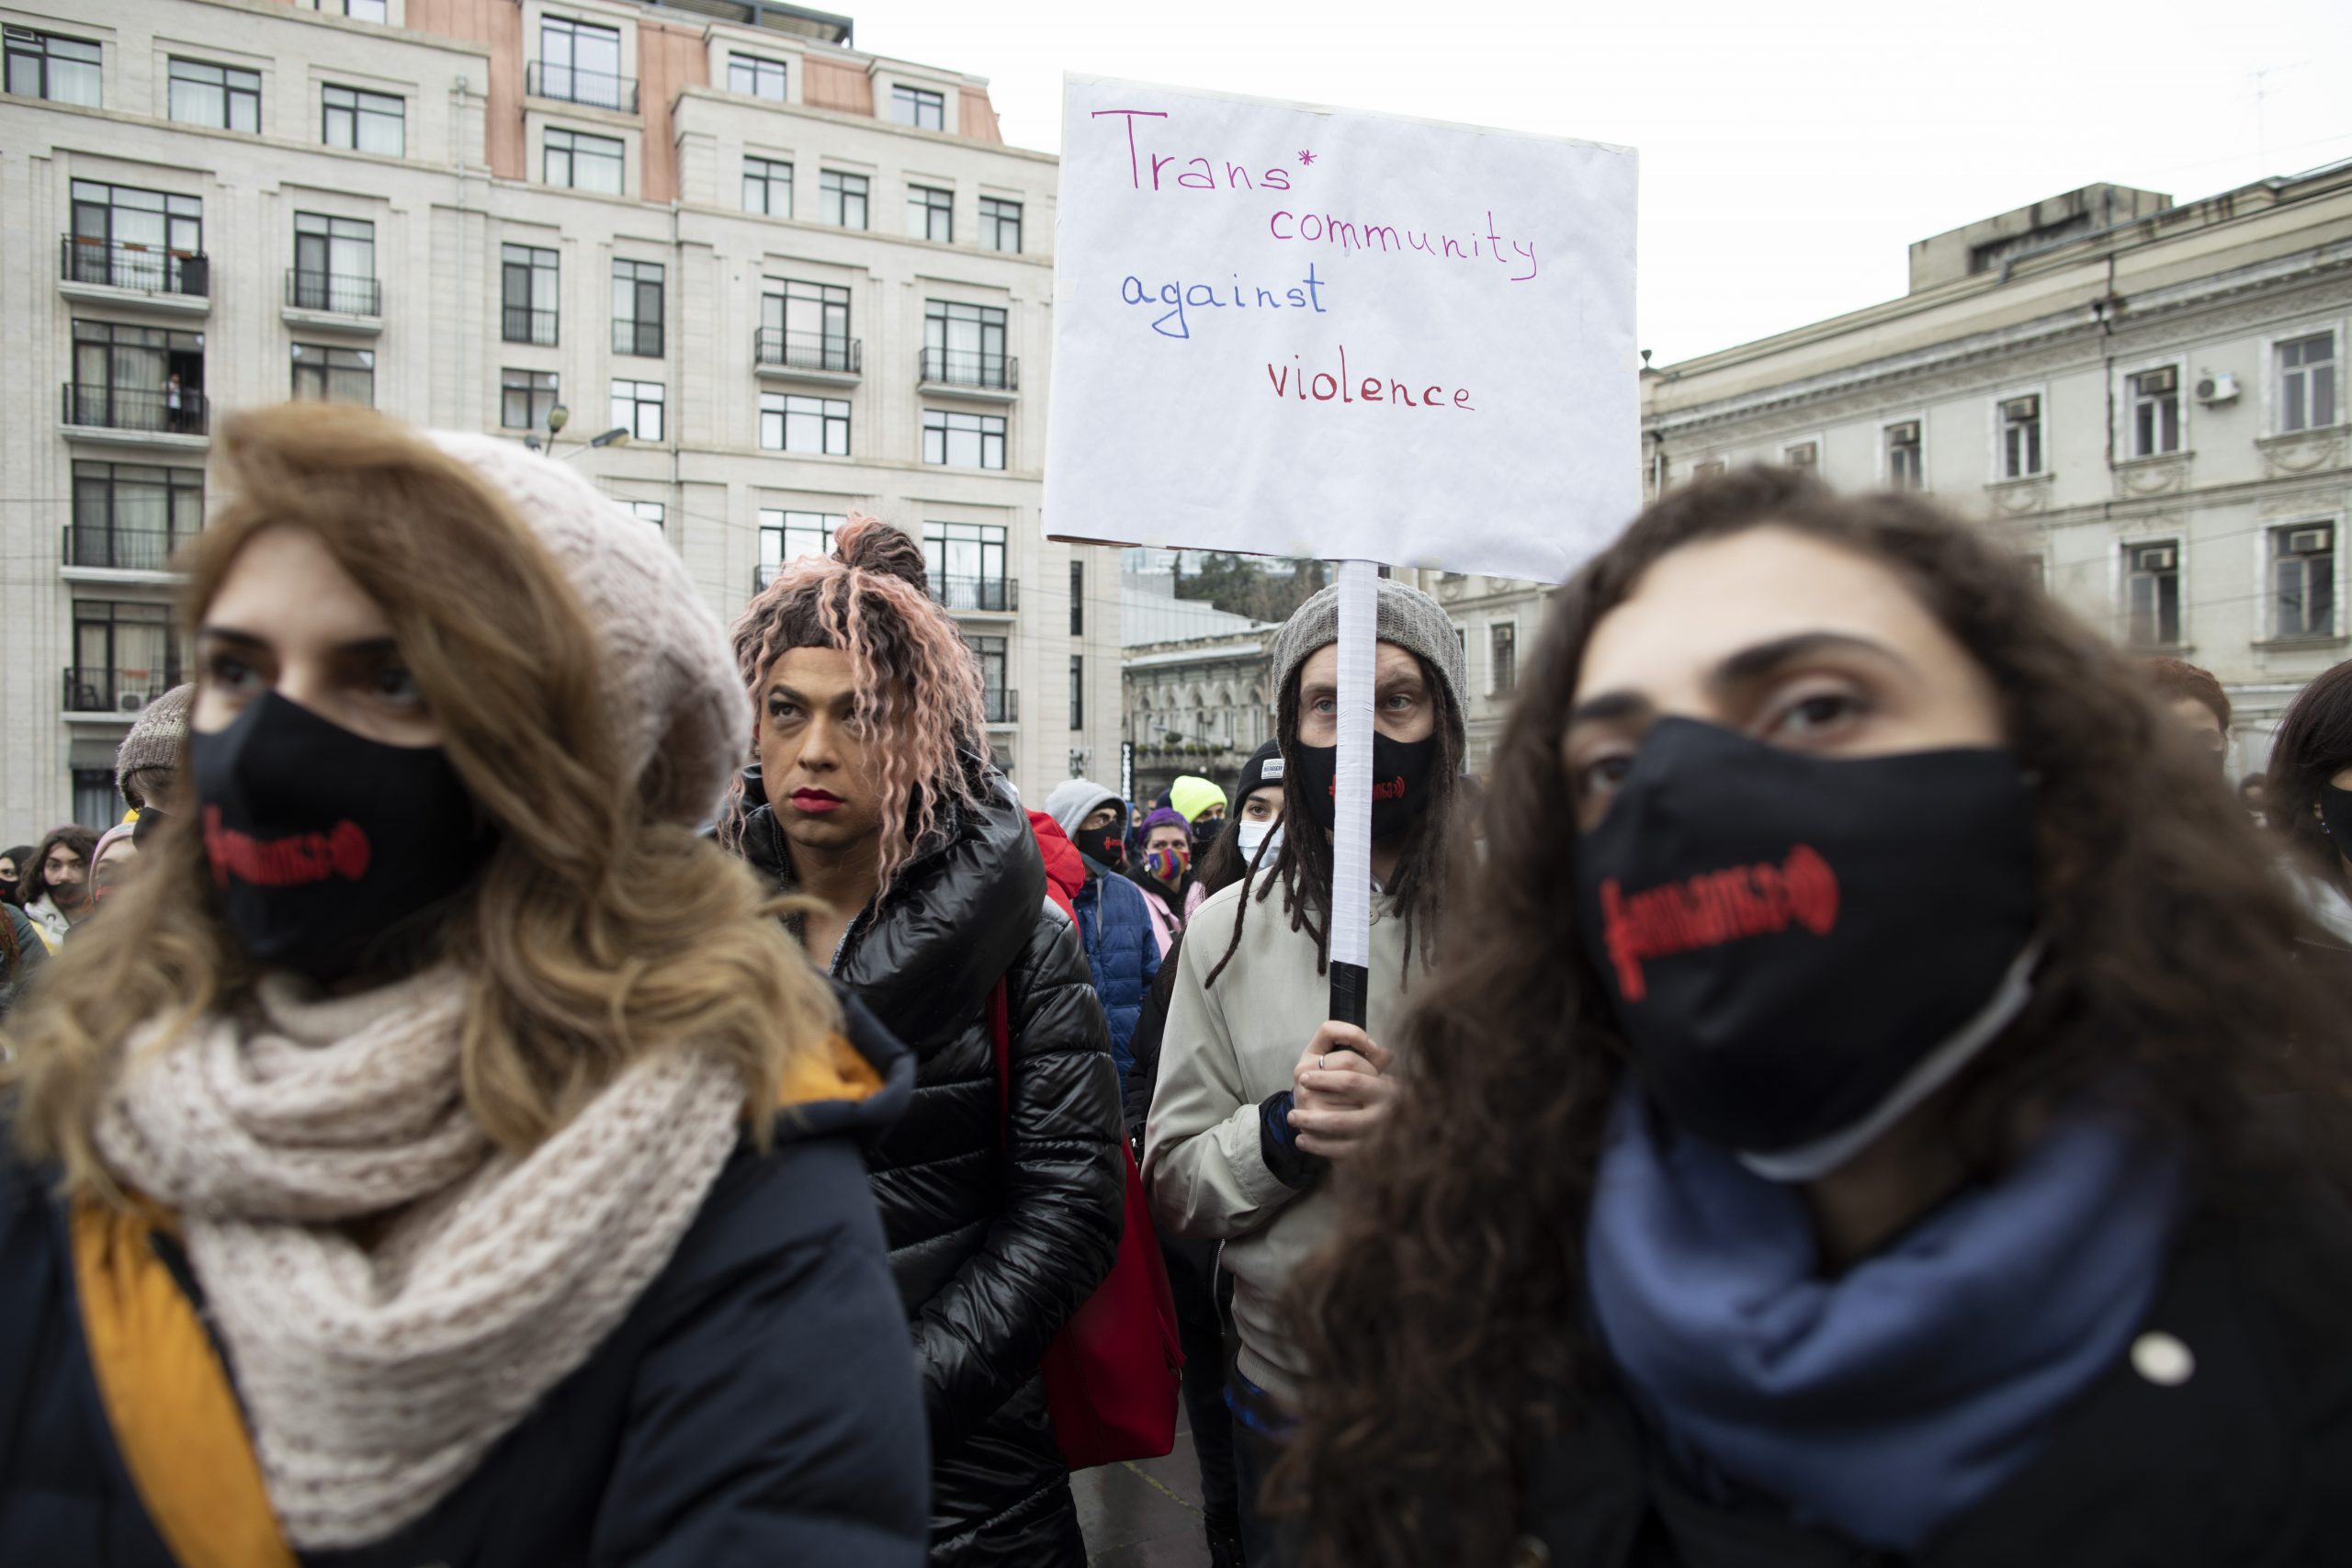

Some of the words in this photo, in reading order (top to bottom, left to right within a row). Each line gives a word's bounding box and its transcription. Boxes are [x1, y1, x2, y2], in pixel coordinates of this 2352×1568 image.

[1270, 210, 1538, 281] community
[1121, 262, 1327, 340] against
[1267, 344, 1476, 412] violence
